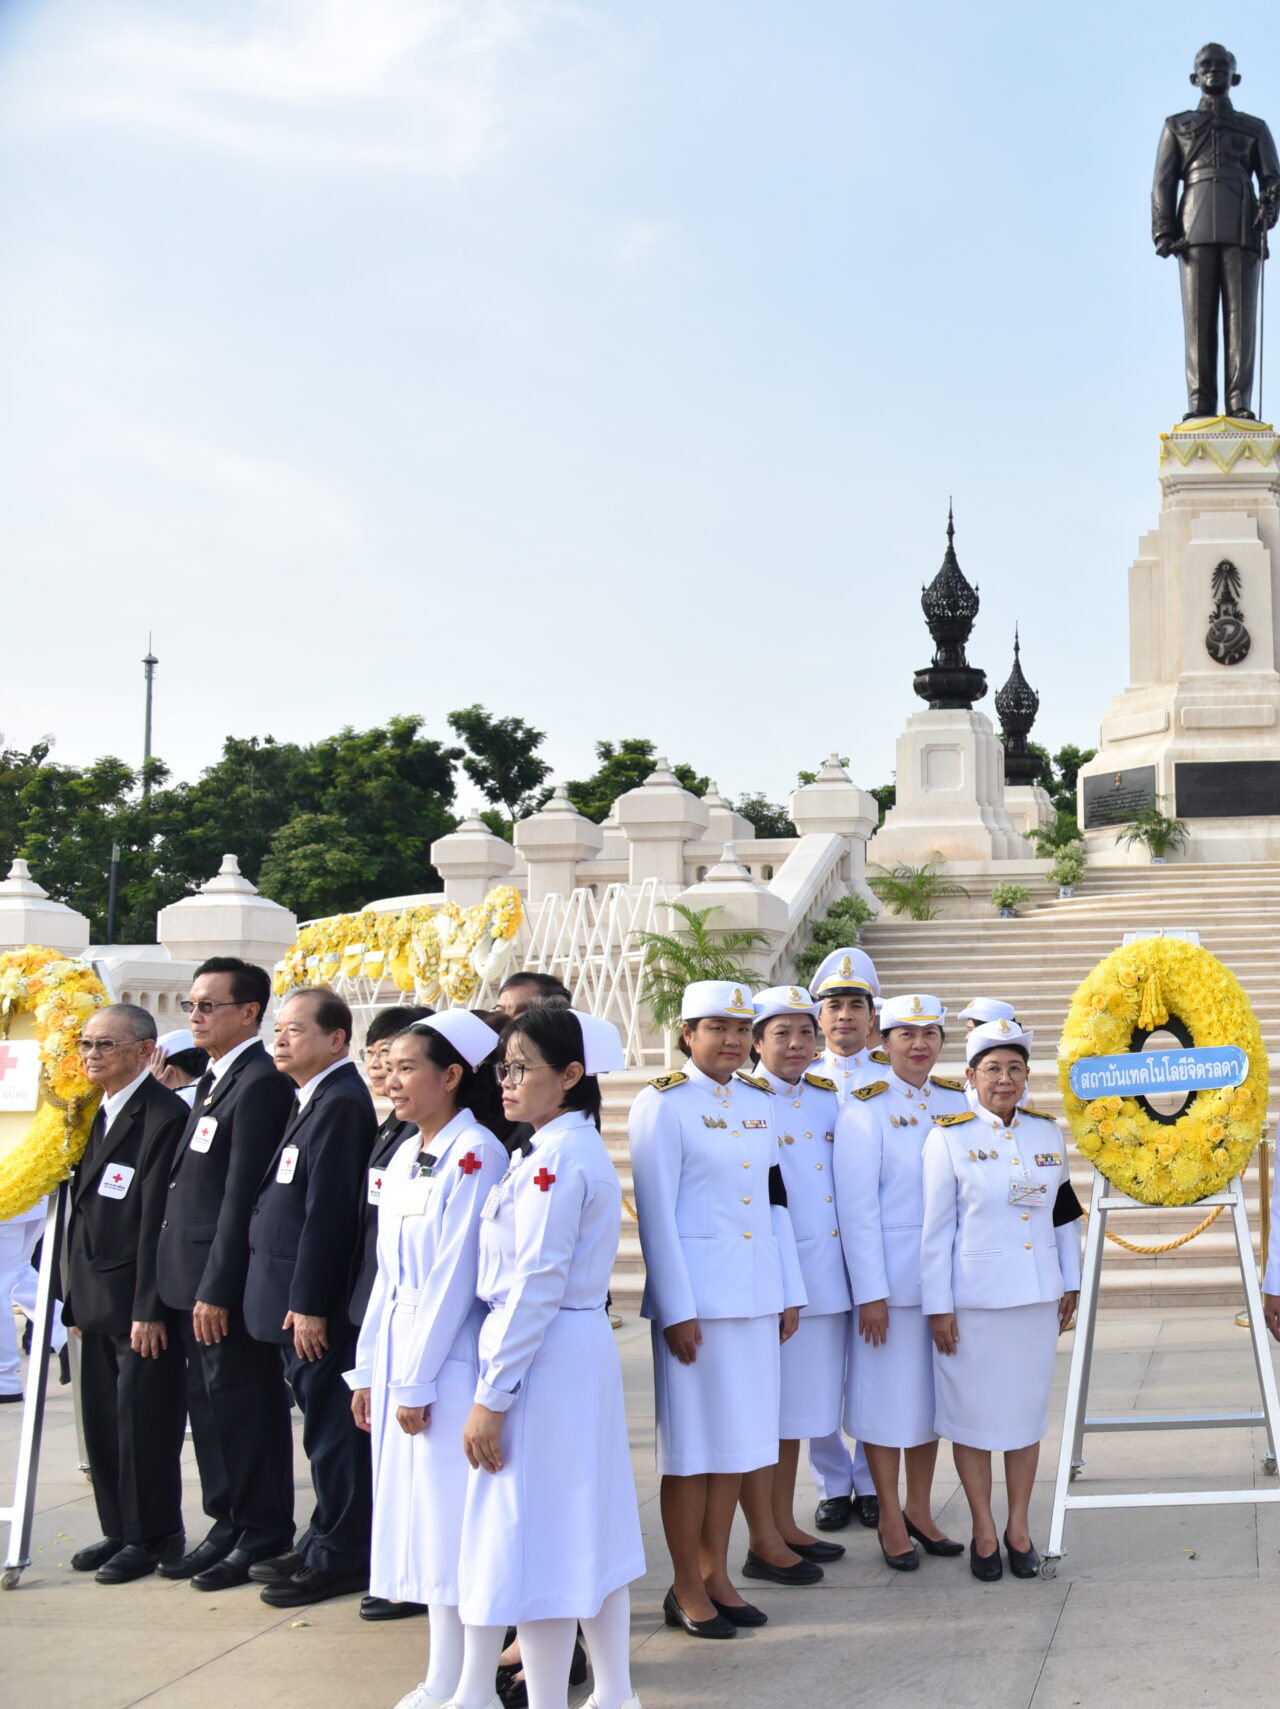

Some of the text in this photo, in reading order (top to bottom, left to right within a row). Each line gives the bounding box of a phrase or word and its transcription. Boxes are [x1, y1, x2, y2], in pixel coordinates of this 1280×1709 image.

[1080, 1056, 1239, 1089] สถาบันเทคโนโลยีจิตรลดา
